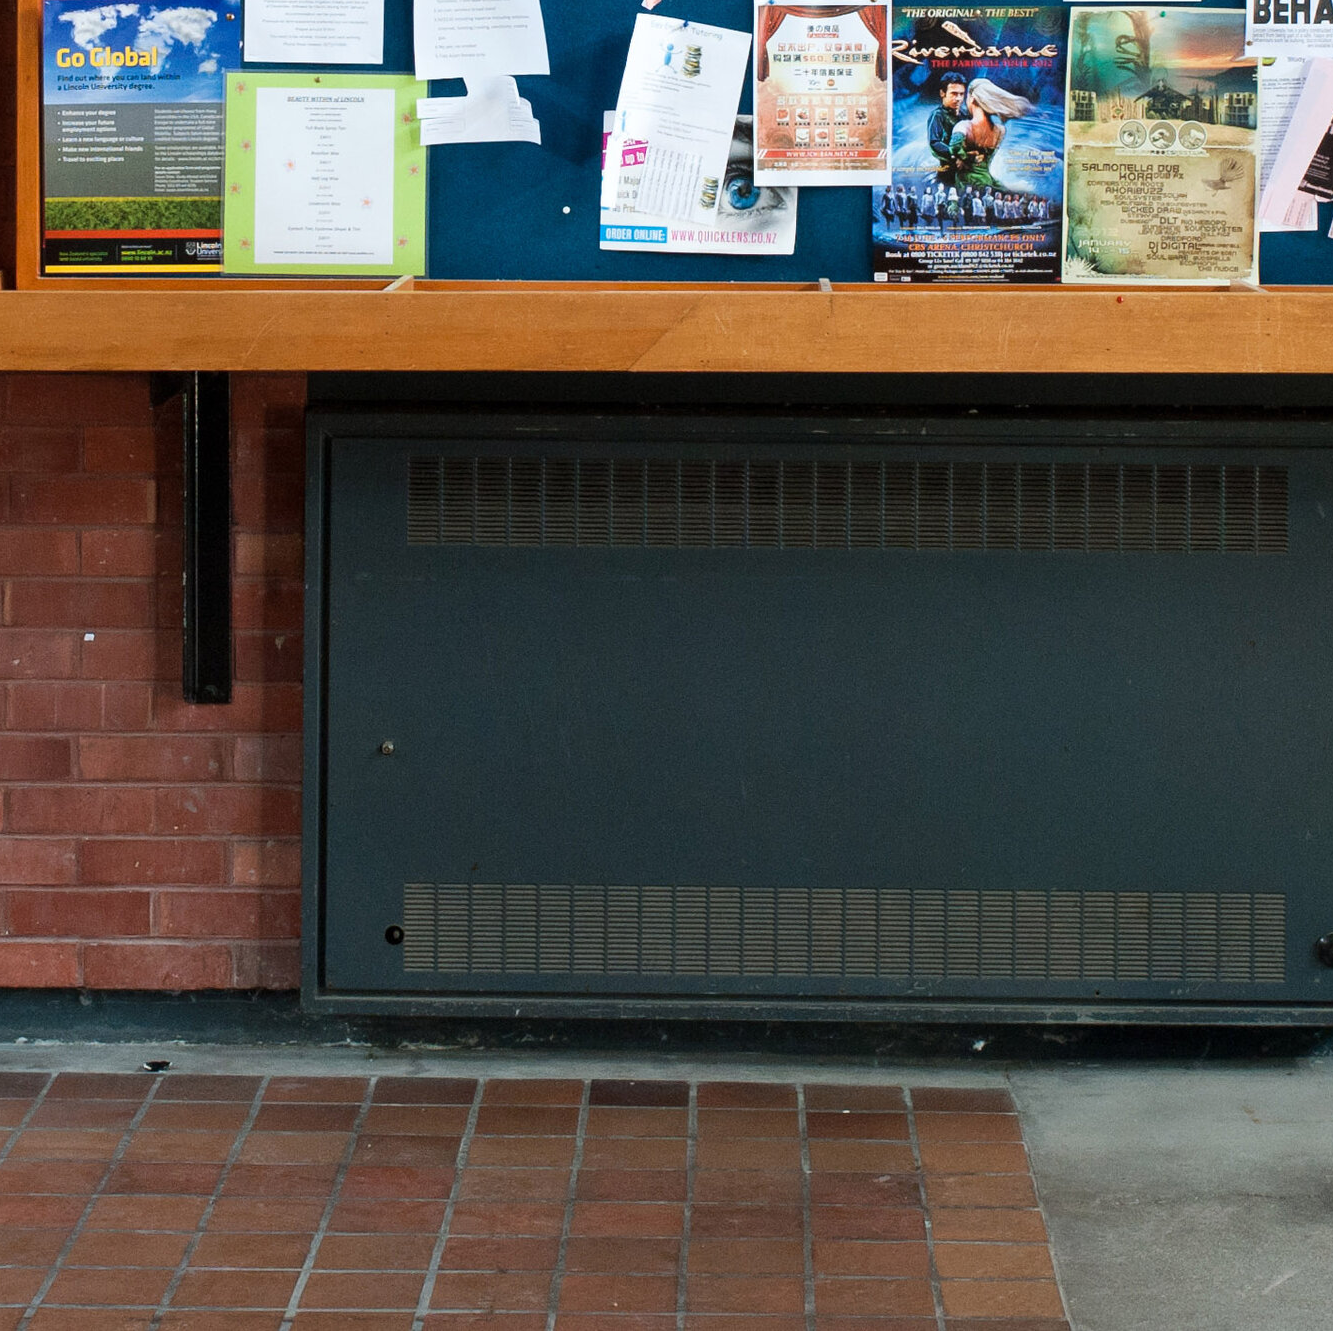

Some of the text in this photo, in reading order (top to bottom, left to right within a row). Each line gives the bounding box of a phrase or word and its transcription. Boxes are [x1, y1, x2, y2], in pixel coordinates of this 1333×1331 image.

[891, 21, 1058, 65] Riverdance
[55, 46, 158, 68] Go Global
[1082, 163, 1179, 173] SALMONELLA DUB
[1119, 172, 1153, 181] KORA
[605, 227, 666, 241] ORDER ONLINE:
[670, 229, 777, 244] WWW.QUICKLENS.CO.NZ
[960, 243, 1033, 251] CHRISTCHURCH
